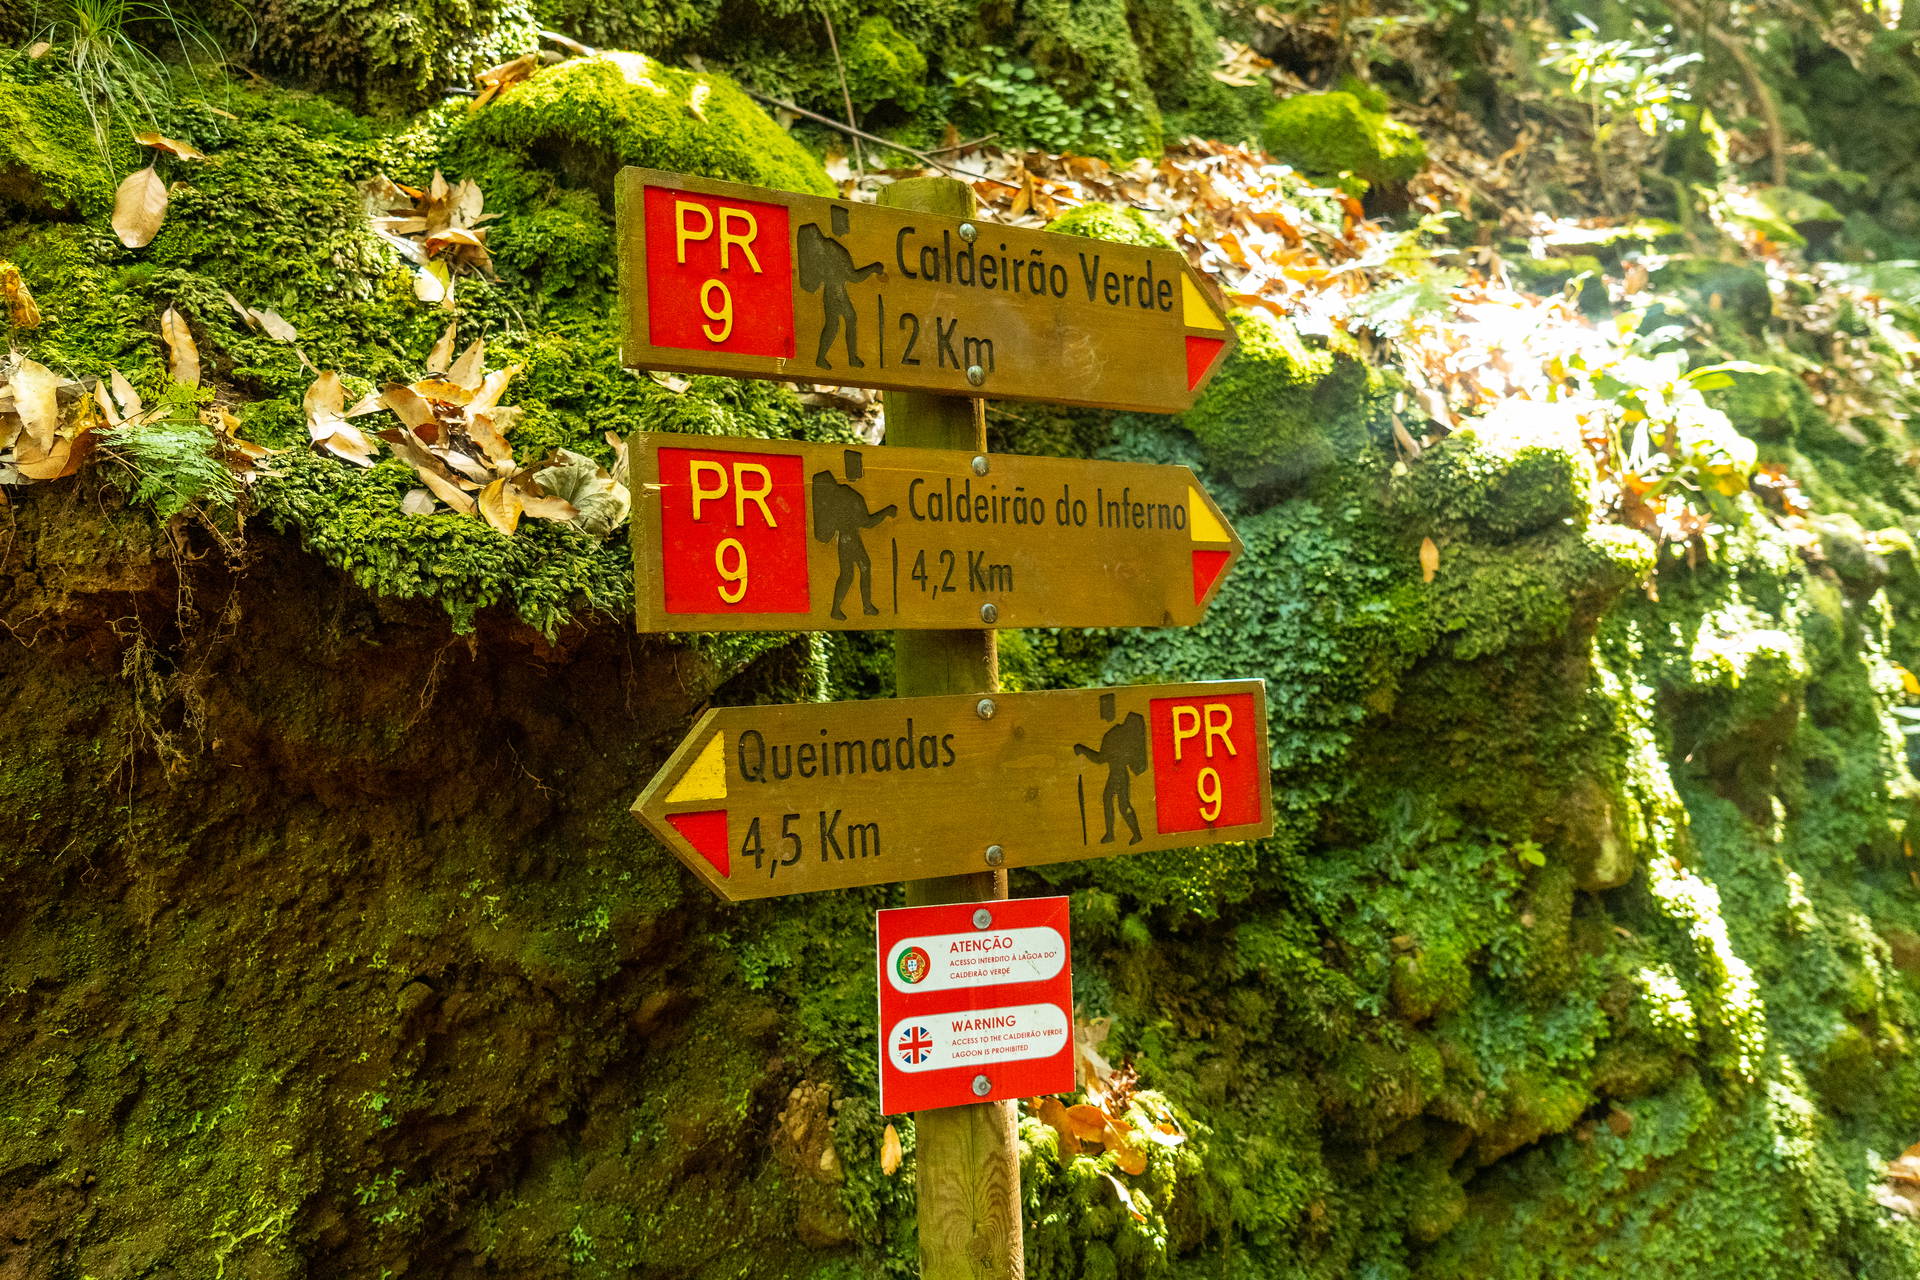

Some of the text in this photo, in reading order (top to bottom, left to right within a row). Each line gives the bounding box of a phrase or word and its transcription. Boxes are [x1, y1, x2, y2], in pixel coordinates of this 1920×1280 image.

[675, 200, 763, 274] PR
[896, 226, 1174, 312] Caldeirão Verde
[700, 278, 734, 343] 9
[899, 313, 996, 374] 2 Km
[689, 459, 778, 528] PR
[908, 477, 1187, 531] Caldeirão do Inferno
[715, 537, 748, 604] 9
[911, 549, 1013, 600] 4,2 Km
[738, 718, 956, 784] Queimadas
[1171, 703, 1237, 761] PR
[1196, 766, 1222, 822] 9
[741, 809, 881, 879] 4,5 Km
[950, 935, 1013, 953] ATENÇÃO
[950, 958, 976, 967] ACESSO
[978, 955, 1010, 965] INTERDITO
[1012, 952, 1017, 961] À
[1018, 951, 1043, 961] LAGOA
[950, 967, 1011, 980] CALDEIRÃO VERDE
[951, 1028, 1063, 1047] ACCESS TO THE CALDEIRÃO VERDE
[952, 1015, 1016, 1032] WARNING
[951, 1050, 983, 1060] LAGOON
[992, 1045, 1029, 1055] PROHIBITED
